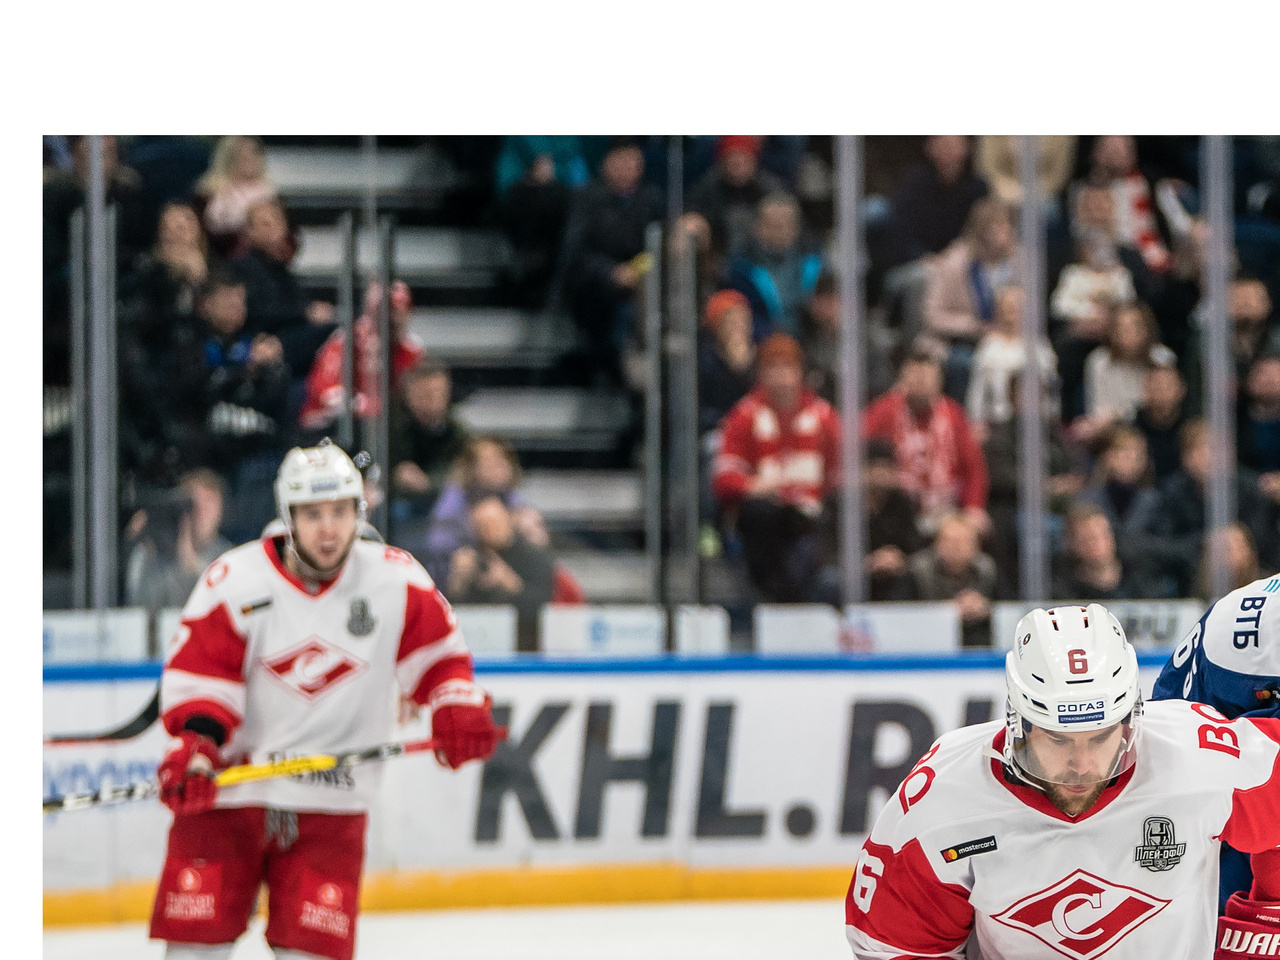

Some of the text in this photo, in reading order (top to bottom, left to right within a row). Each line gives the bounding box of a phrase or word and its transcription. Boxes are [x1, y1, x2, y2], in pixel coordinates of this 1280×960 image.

[1232, 596, 1267, 650] ВТБ
[1067, 648, 1089, 675] 6
[1057, 700, 1105, 713] СОГАЗ
[473, 698, 993, 846] KHL.R
[958, 838, 996, 857] mastercard
[853, 848, 885, 914] 6
